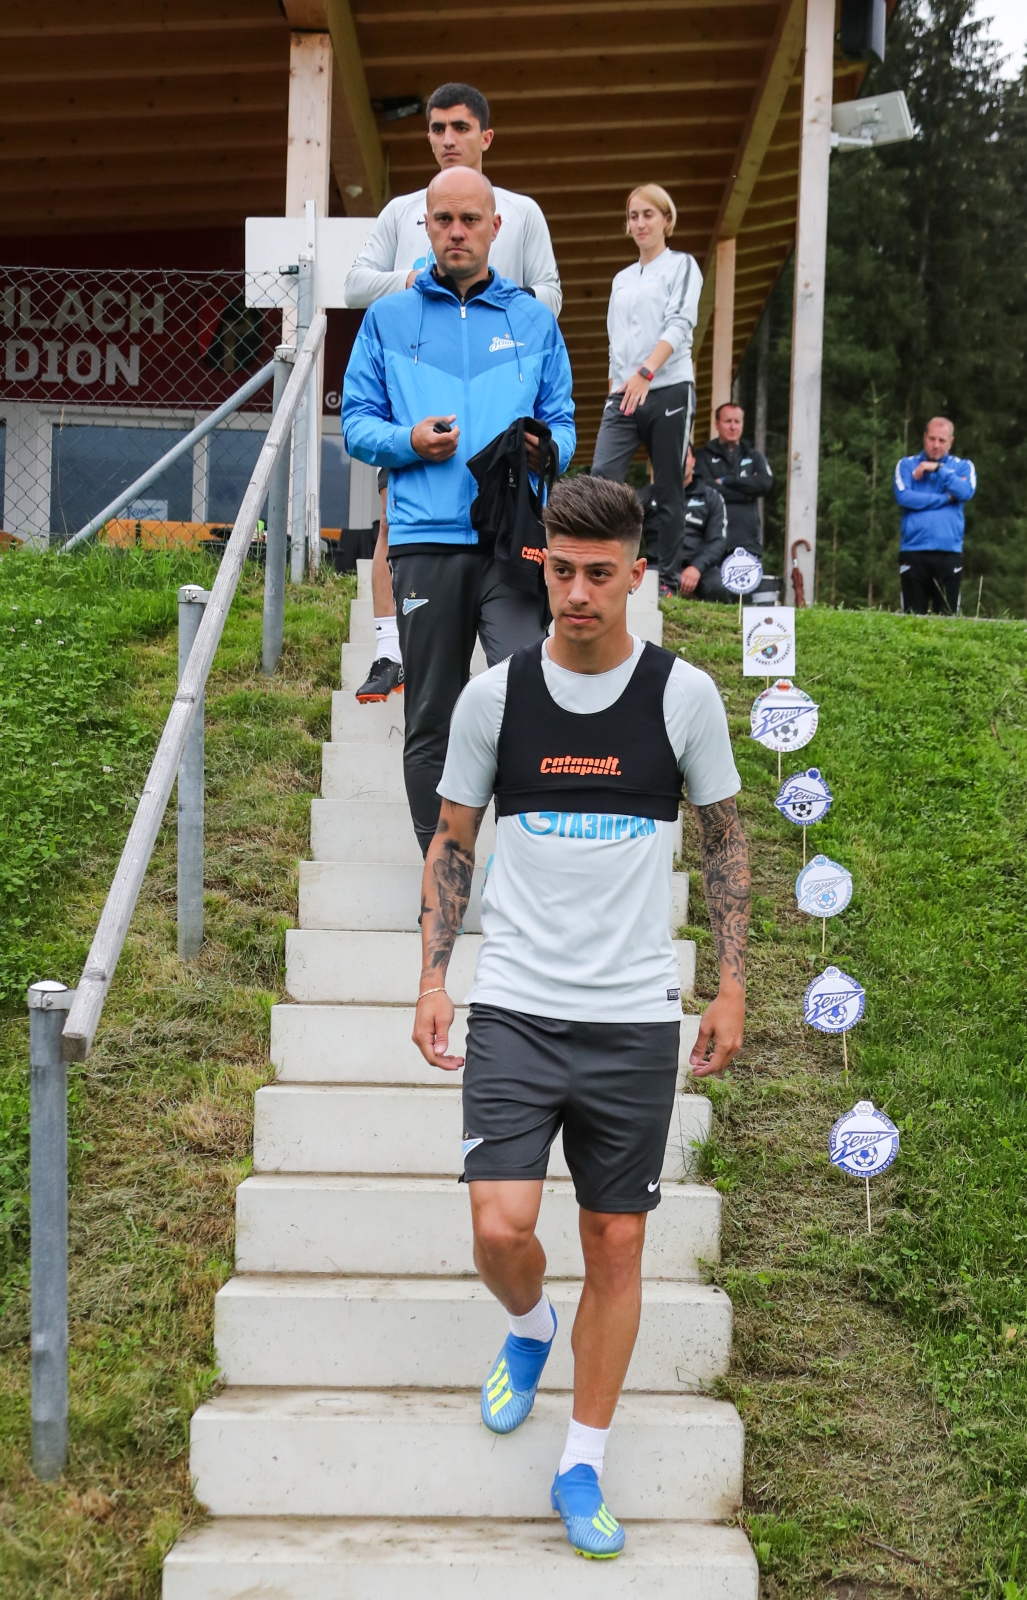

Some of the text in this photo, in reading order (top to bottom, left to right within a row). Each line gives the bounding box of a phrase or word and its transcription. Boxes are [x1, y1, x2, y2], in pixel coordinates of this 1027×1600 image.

[0, 339, 140, 386] DION
[751, 706, 817, 739] Зенит
[775, 786, 832, 806] Зенит
[804, 990, 865, 1023] Зенит
[830, 1131, 898, 1163] Зенит
